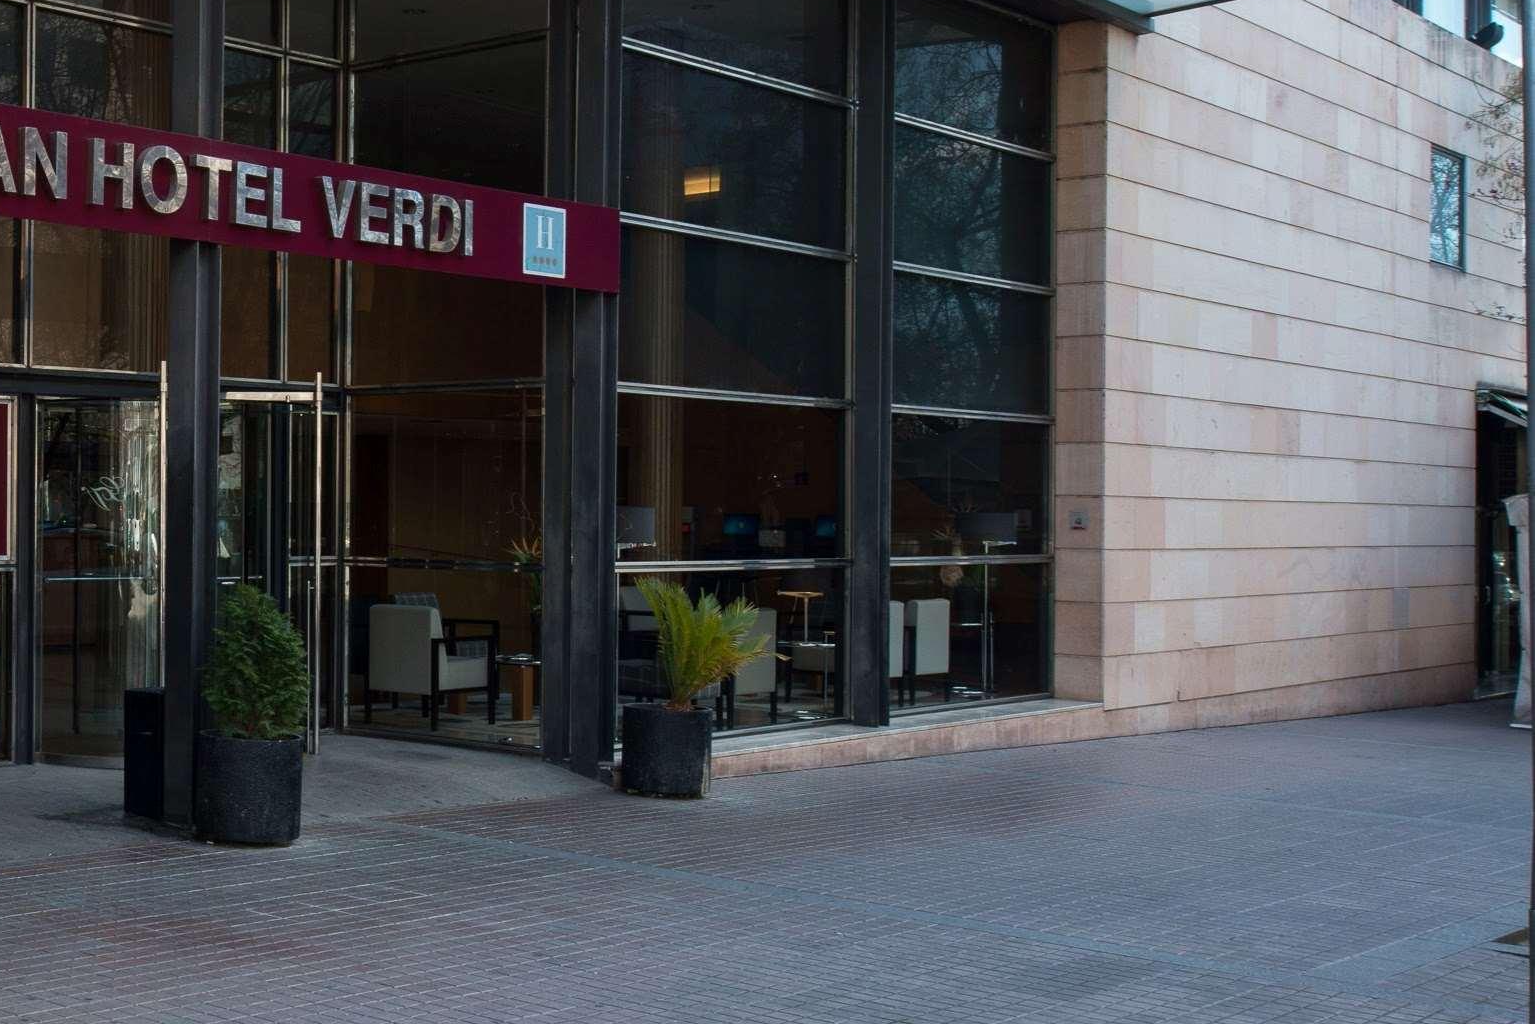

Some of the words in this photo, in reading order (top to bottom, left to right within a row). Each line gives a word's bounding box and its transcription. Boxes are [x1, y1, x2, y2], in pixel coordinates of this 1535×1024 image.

[87, 136, 302, 234] HOTEL
[318, 175, 474, 257] VERDI
[536, 215, 555, 250] H
